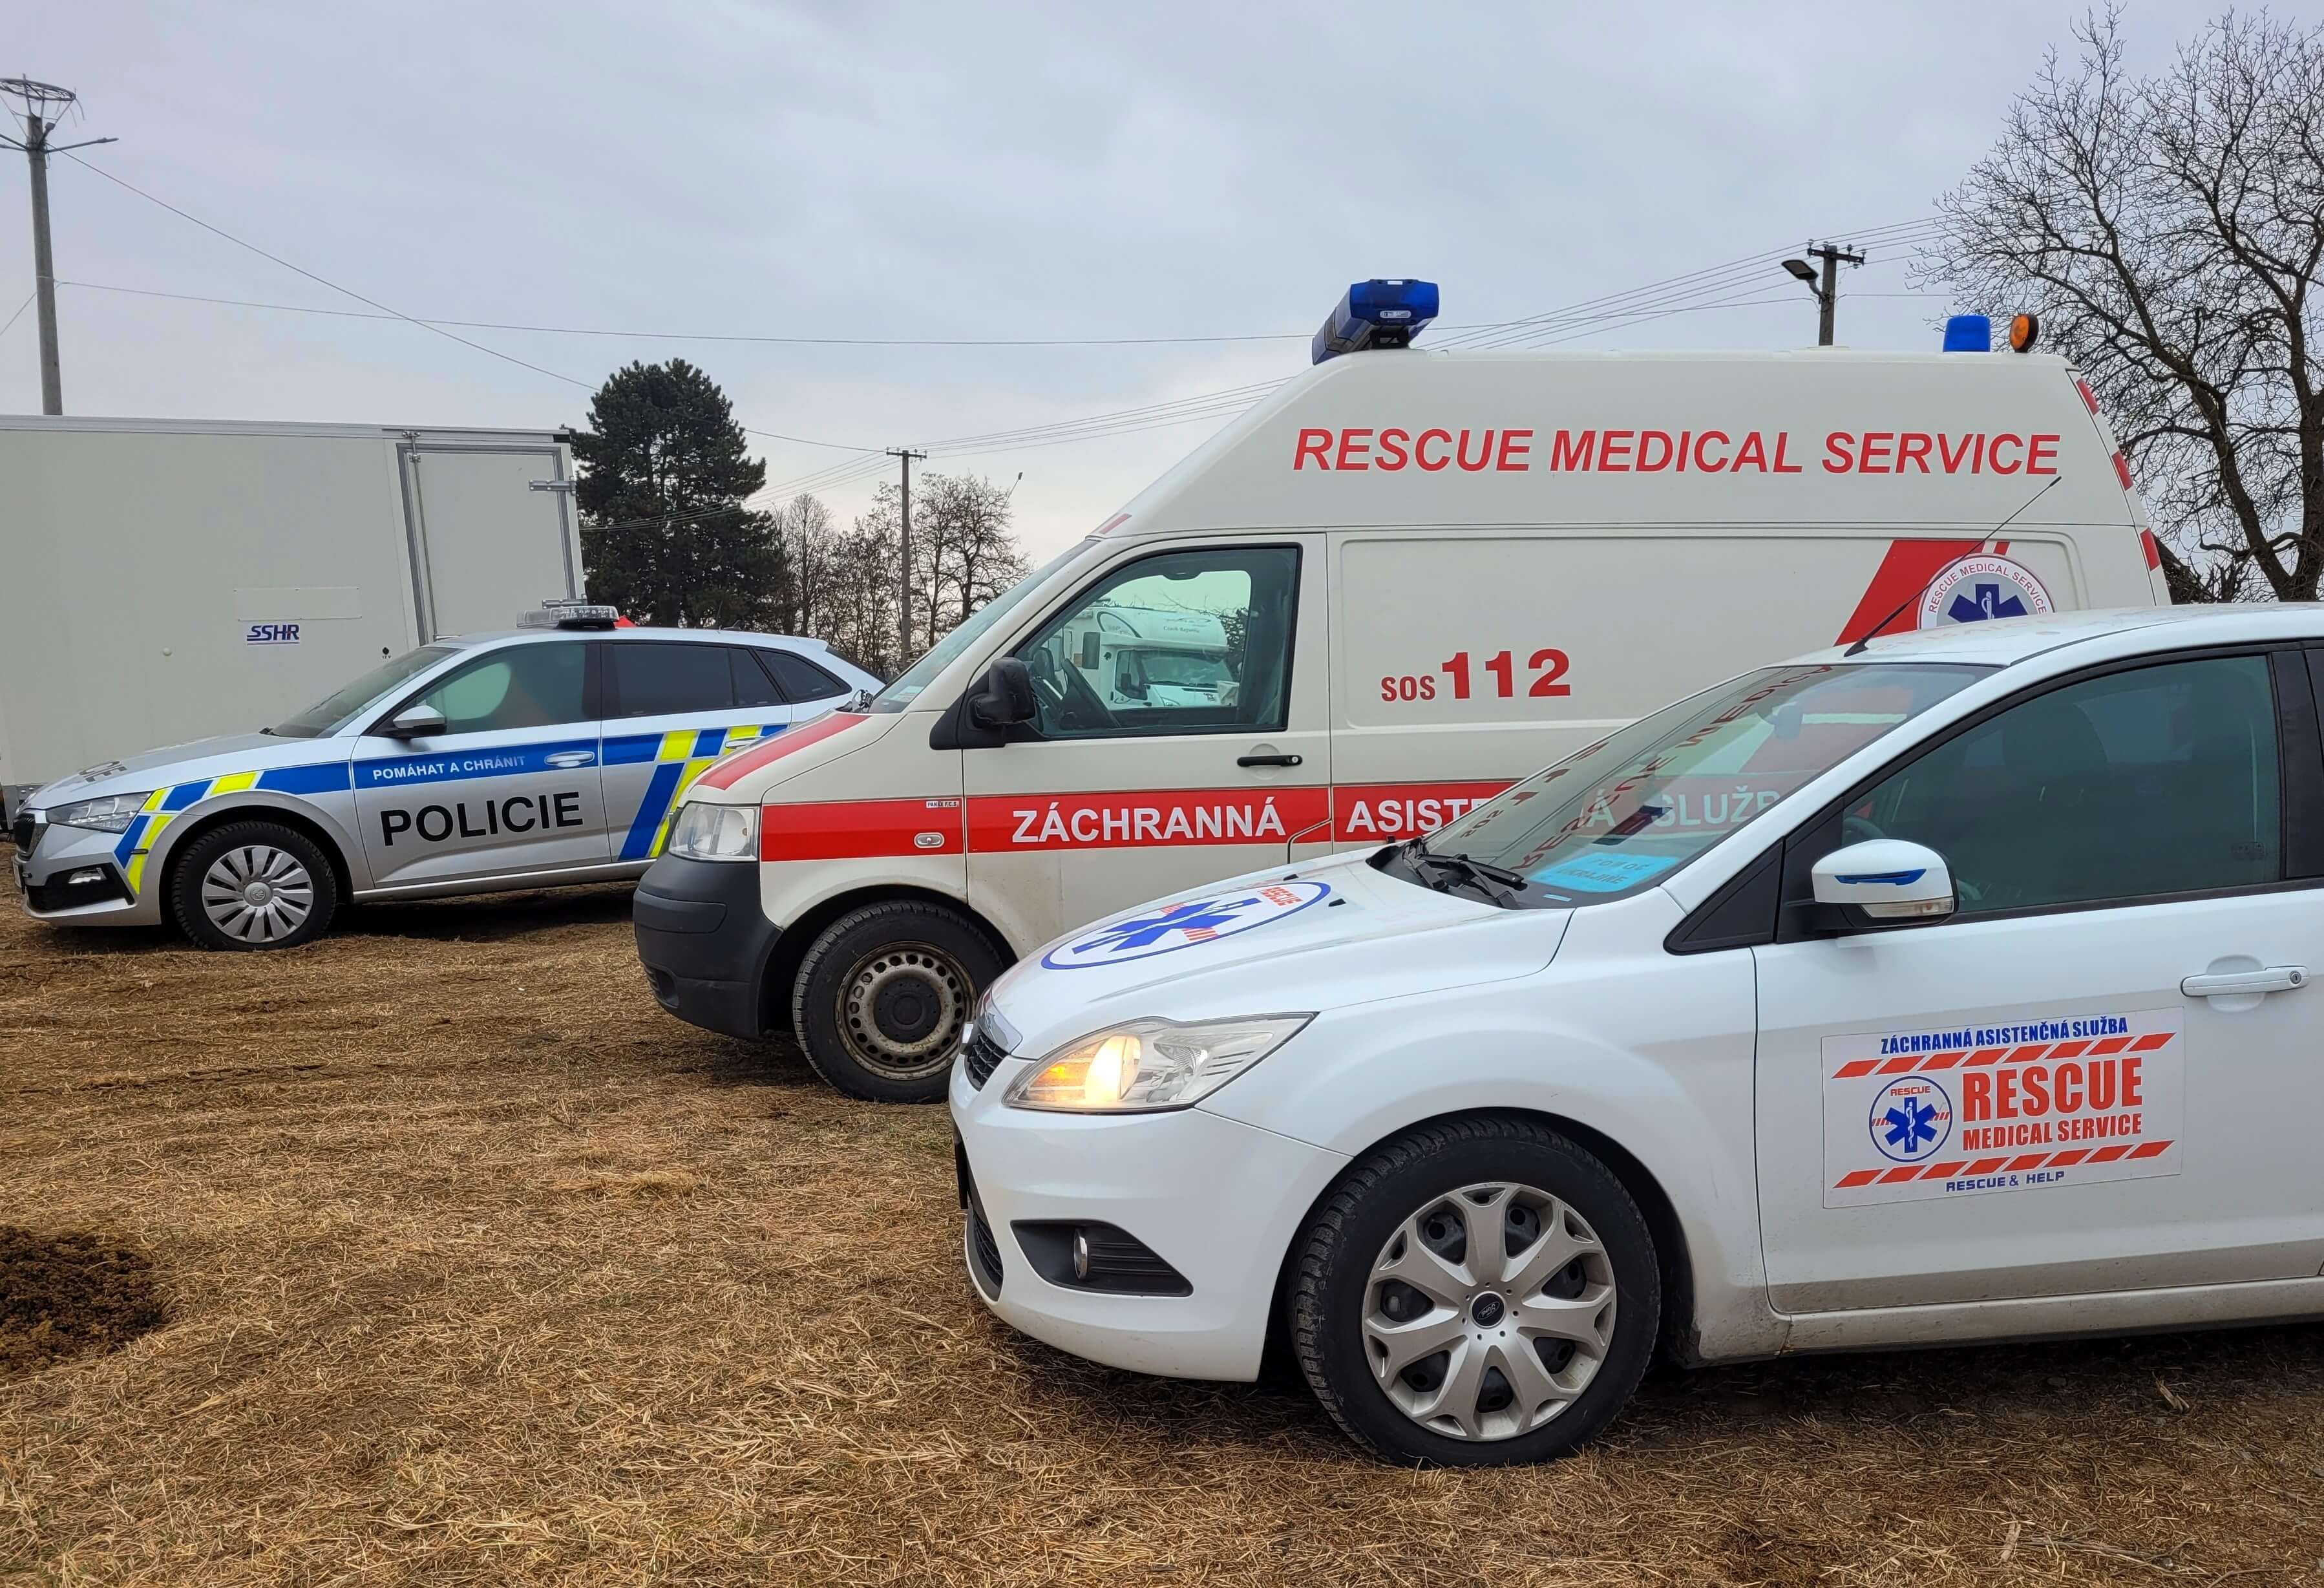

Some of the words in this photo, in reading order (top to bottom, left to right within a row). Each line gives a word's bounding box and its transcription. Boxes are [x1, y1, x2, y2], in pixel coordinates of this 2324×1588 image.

[1293, 428, 1534, 472] RESCUE
[1550, 429, 1802, 473] MEDICAL
[1822, 432, 2060, 475] SERVICE
[1928, 573, 1959, 613] RESCUE
[1960, 563, 2009, 577] MEDICAL
[2012, 572, 2047, 614] SERVICE
[247, 624, 299, 641] SSHR
[1382, 675, 1435, 702] SOS
[1441, 648, 1570, 699] 112
[373, 763, 445, 780] POMÁHAT
[450, 762, 460, 772] A
[463, 755, 526, 772] CHRÁNIT
[380, 792, 584, 847] POLICIE
[1012, 796, 1286, 843] ZÁCHRANNÁ
[1881, 1028, 1972, 1054] ZÁCHRANNÁ
[1976, 1020, 2069, 1046] ASISTENČNÁ
[2073, 1016, 2128, 1037] SLUŽBA
[1890, 1085, 1931, 1097] RESCUE
[1963, 1057, 2142, 1122] RESCUE
[1963, 1122, 2053, 1151] MEDICAL
[2057, 1113, 2142, 1141] SERVICE
[1946, 1176, 2006, 1192] RESCUE
[2009, 1175, 2018, 1186] &
[2026, 1171, 2064, 1184] HELP
